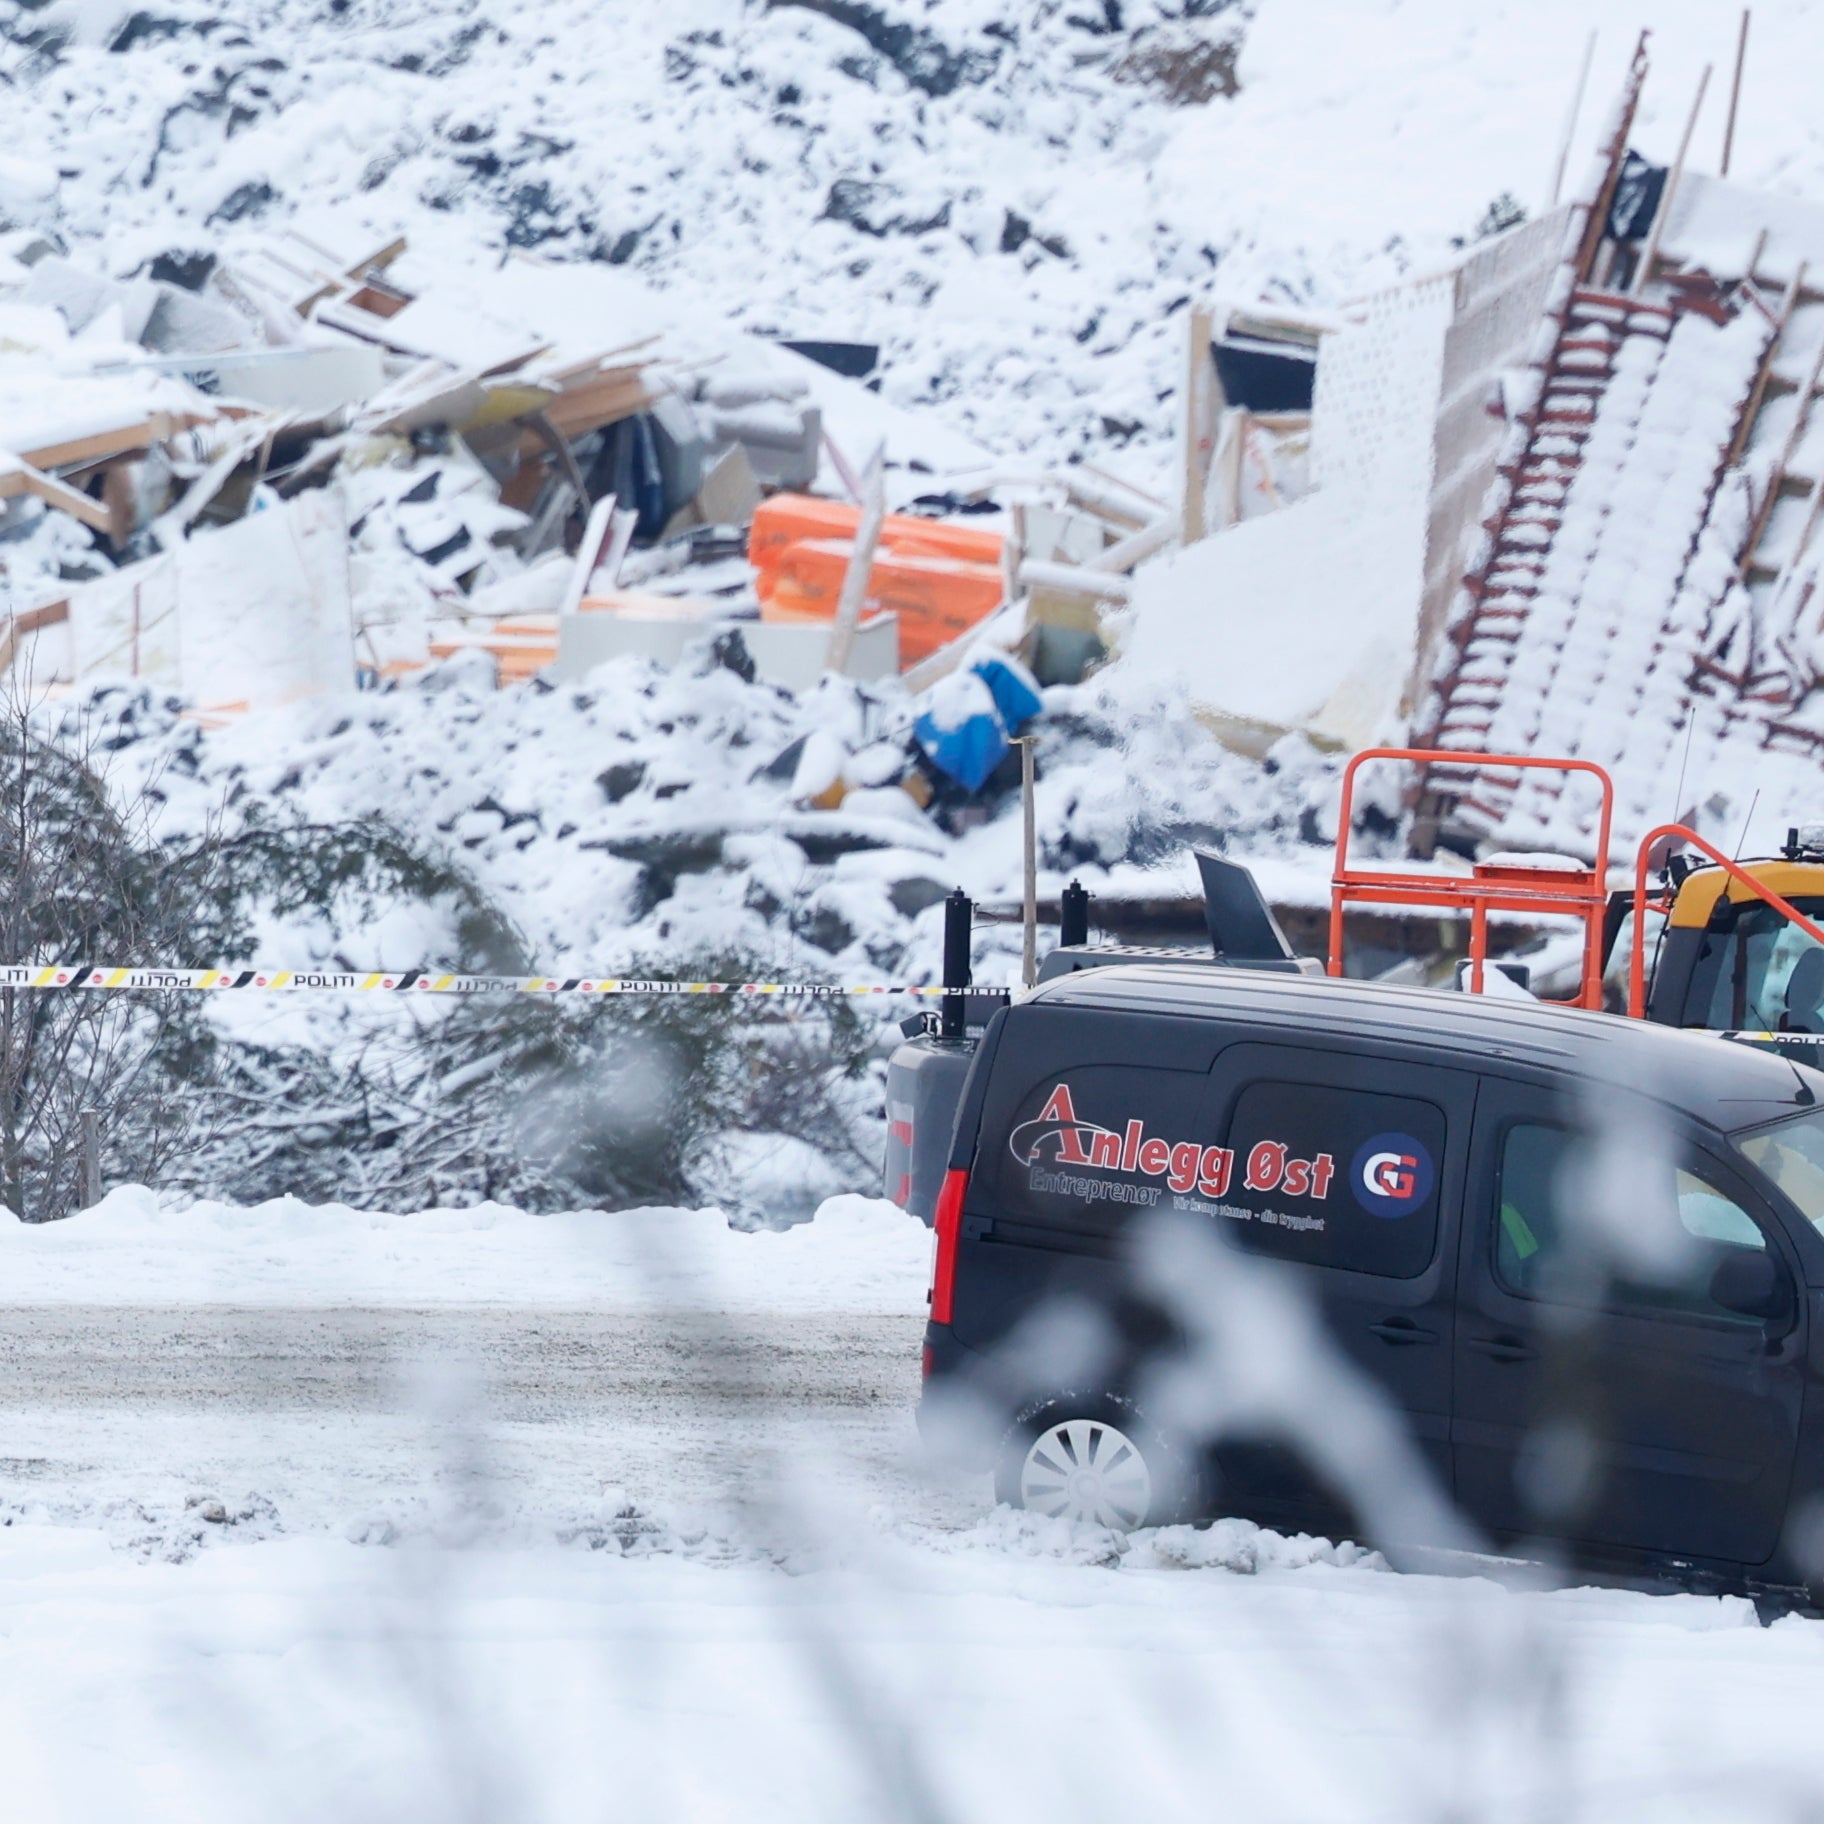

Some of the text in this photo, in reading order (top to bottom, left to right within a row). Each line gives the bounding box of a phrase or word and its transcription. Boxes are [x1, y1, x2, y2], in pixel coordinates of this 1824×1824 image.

[131, 975, 191, 987] POLITI
[294, 975, 354, 987] POLITI
[1028, 1083, 1334, 1199] Anlegg Øst
[1029, 1168, 1161, 1205] Entreprenør
